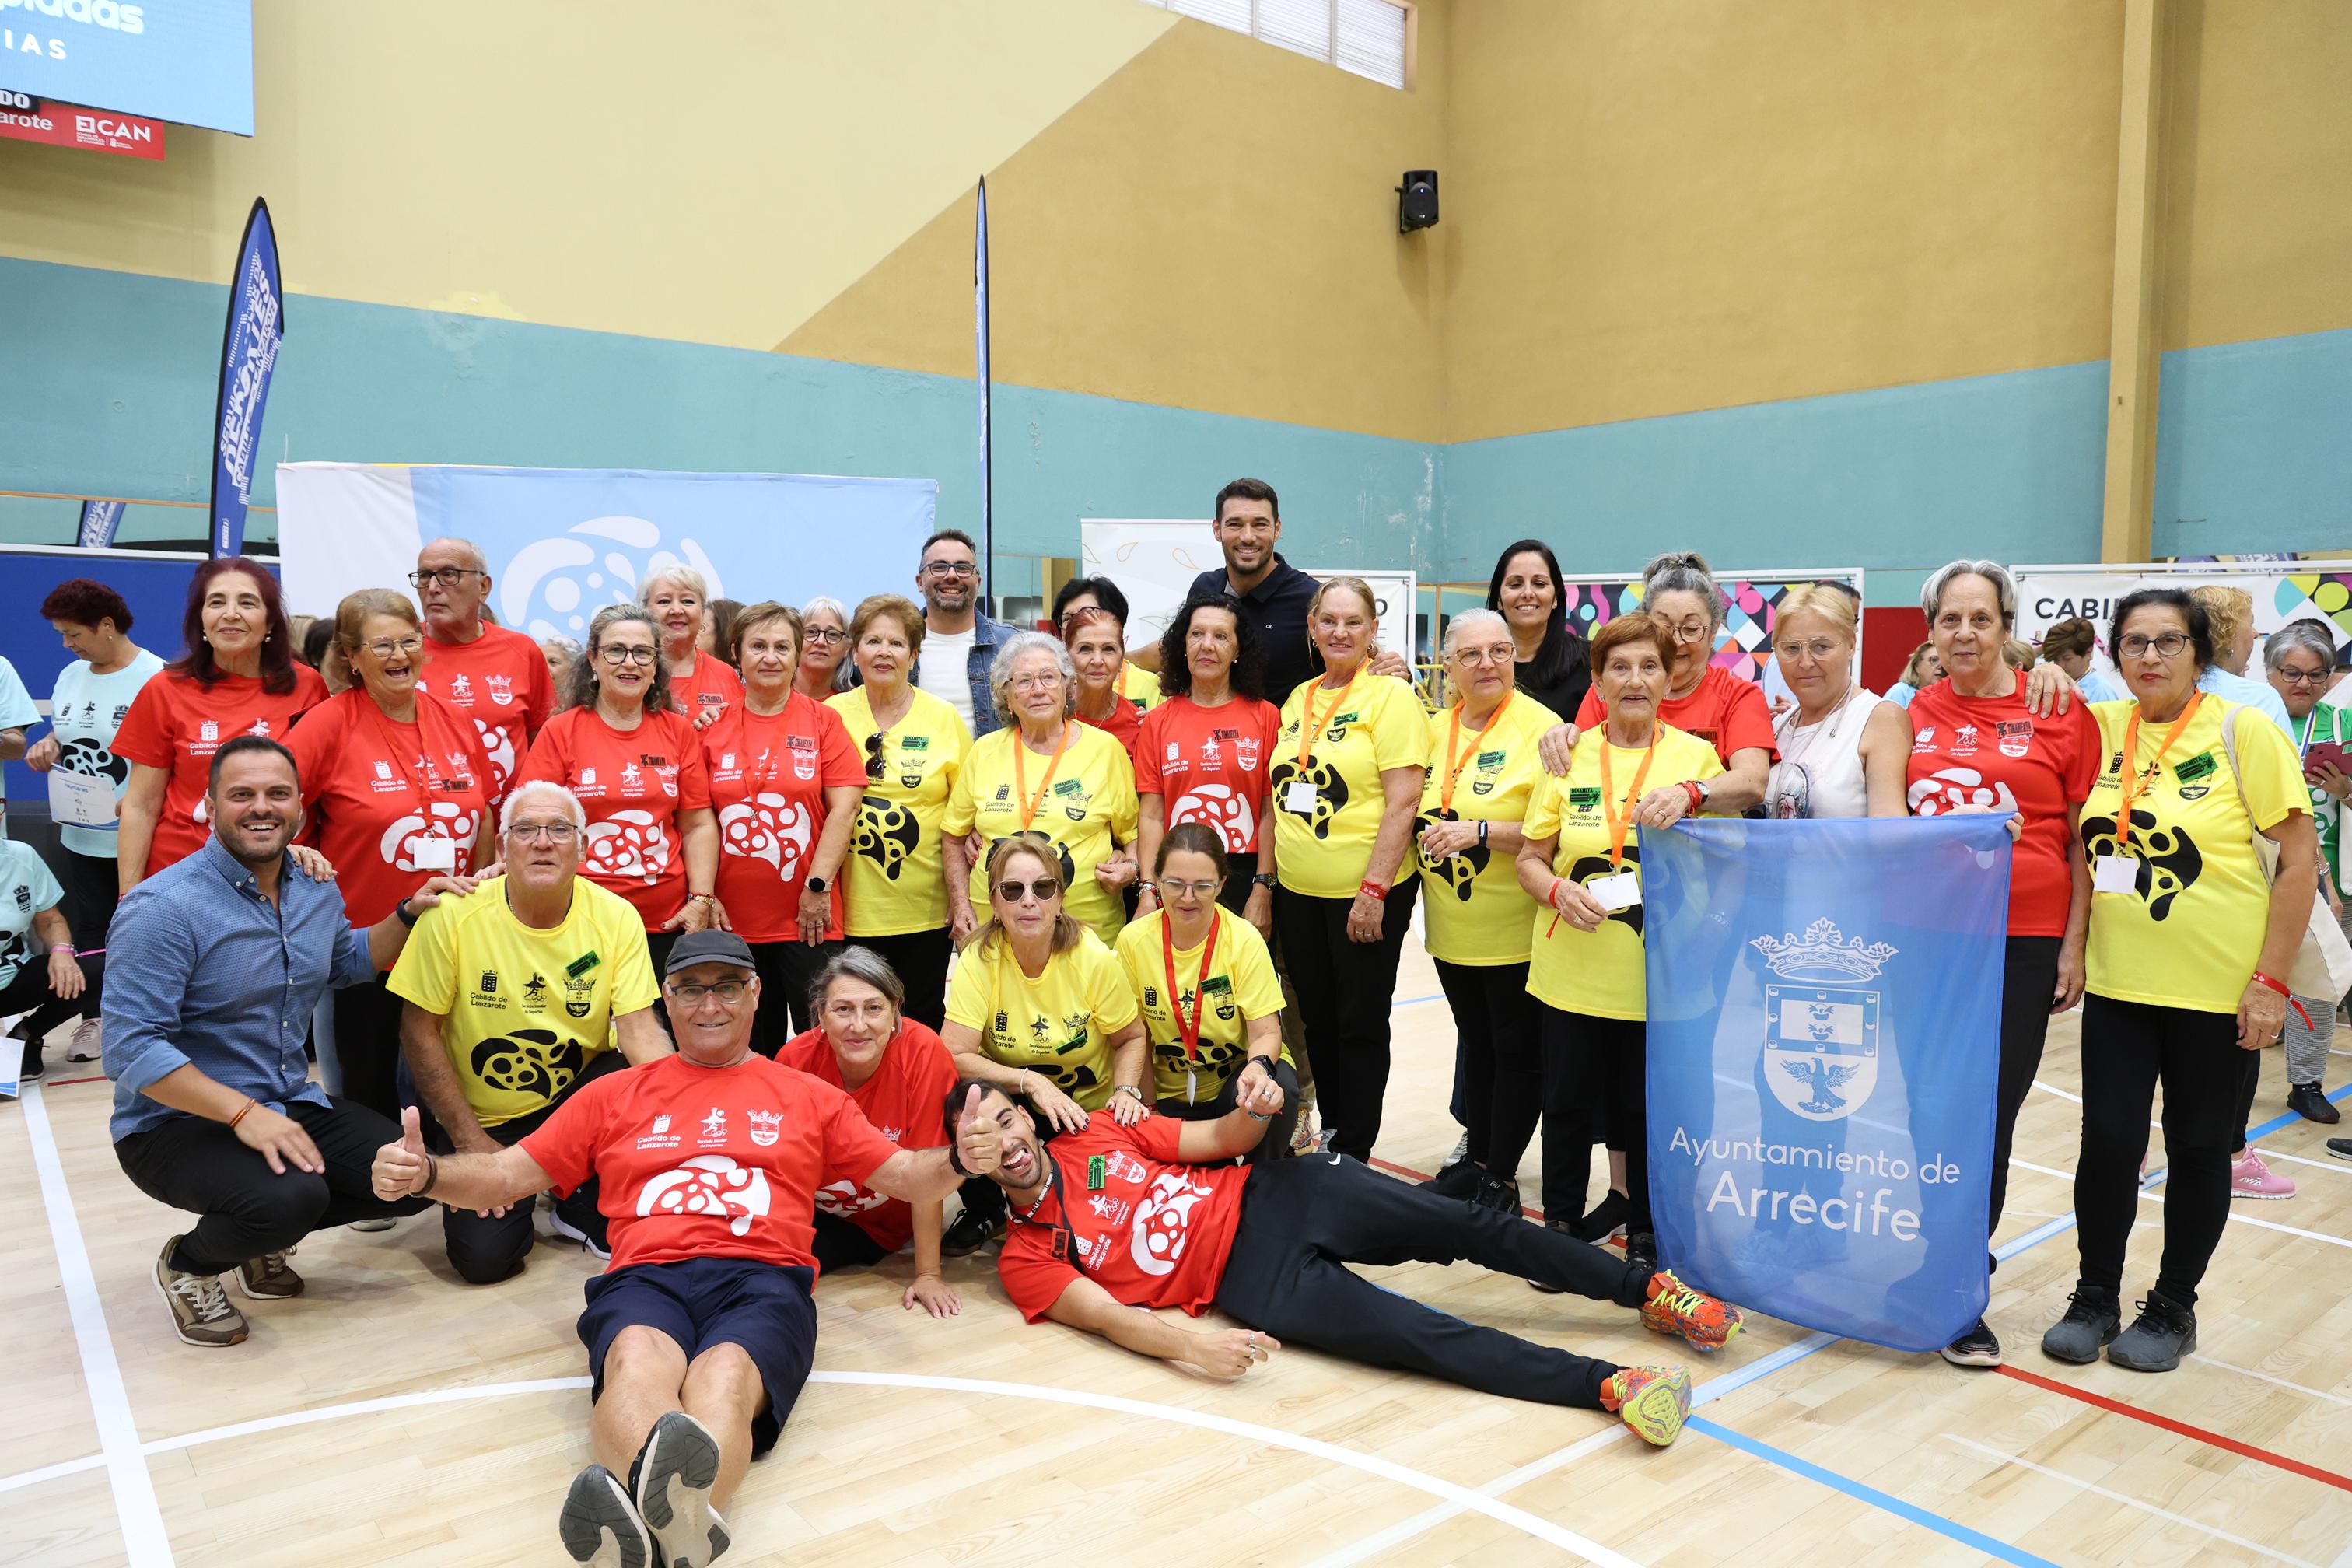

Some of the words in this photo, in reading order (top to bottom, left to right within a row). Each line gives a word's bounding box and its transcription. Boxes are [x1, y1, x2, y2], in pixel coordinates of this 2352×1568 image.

[0, 0, 144, 34] adas
[2175, 756, 2203, 772] DINAMITA
[470, 992, 496, 1002] Cabildo
[471, 1000, 506, 1010] Lanzarote
[1146, 1013, 1166, 1022] nzarote
[637, 1135, 668, 1143] Cabildo
[637, 1141, 678, 1150] Lanzarote
[1669, 1126, 1910, 1180] Ayuntamiento
[1920, 1153, 1962, 1184] de
[1706, 1171, 1921, 1241] Arrecife
[1087, 1244, 1101, 1269] Cabildo
[1098, 1234, 1106, 1244] de
[1094, 1238, 1111, 1271] Lanzarote
